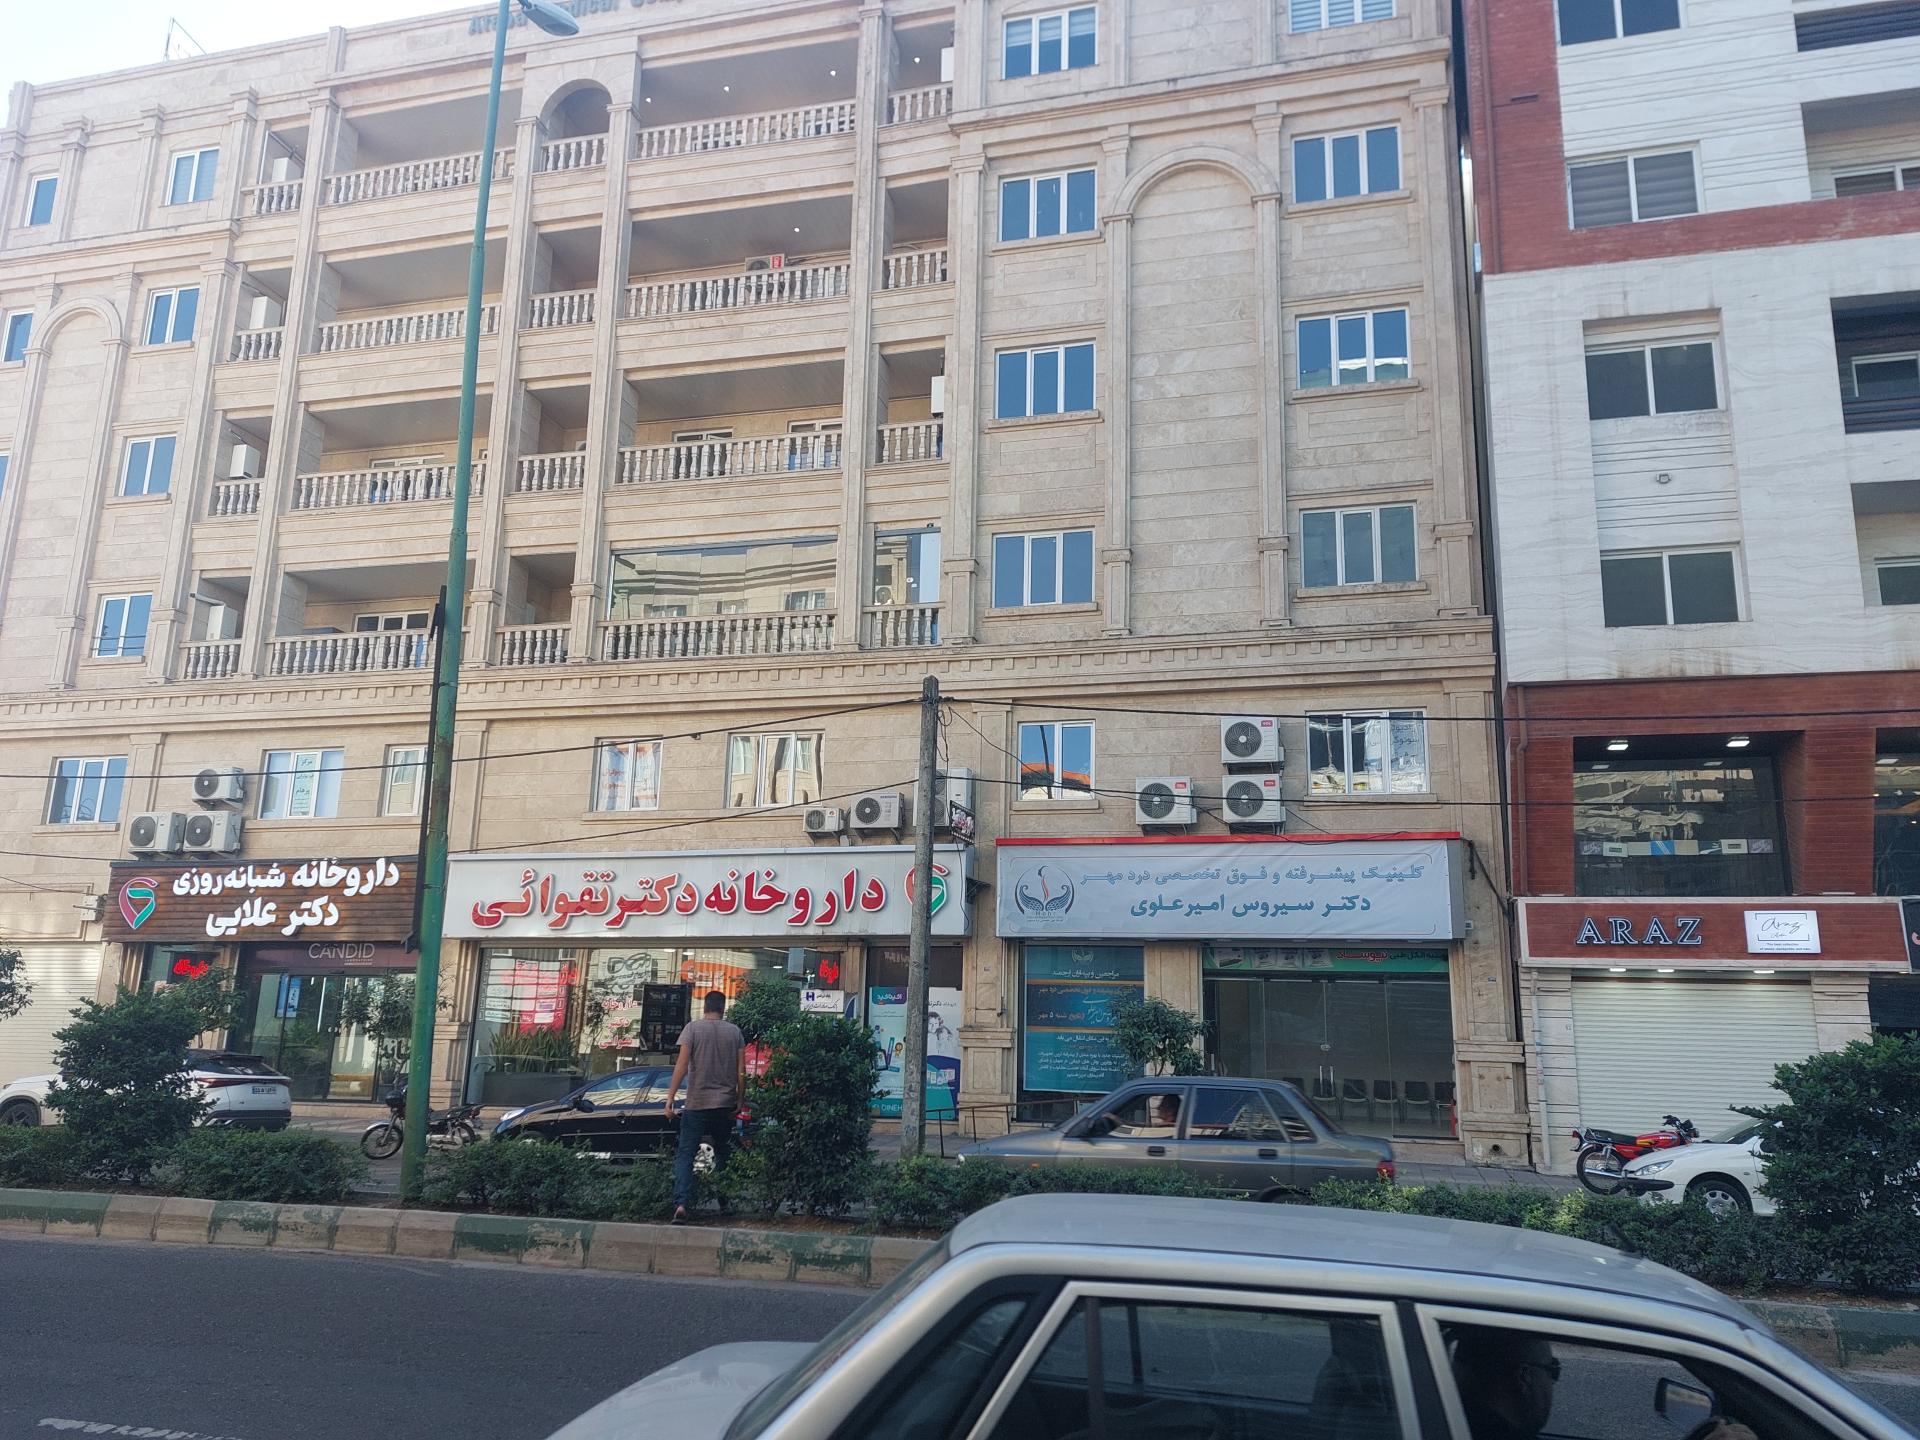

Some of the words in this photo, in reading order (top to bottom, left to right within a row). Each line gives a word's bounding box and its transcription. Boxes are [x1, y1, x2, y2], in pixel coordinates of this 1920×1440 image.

[292, 857, 400, 897] داروخانه
[1080, 870, 1124, 886] مهر
[1127, 869, 1151, 886] درد
[1154, 867, 1222, 886] تخصصی
[1226, 865, 1268, 885] فوق
[1271, 870, 1281, 885] و
[1284, 864, 1356, 885] پیشرفته
[1361, 864, 1425, 883] کلینیک
[470, 867, 613, 929] تقوائی
[603, 872, 700, 929] دکتر
[703, 867, 887, 927] داروخانه
[1321, 894, 1371, 918] دکتر
[205, 896, 278, 938] علایی
[281, 895, 340, 937] دکتر
[1231, 899, 1315, 918] سیروس
[1576, 917, 1703, 945] ARAZ
[308, 942, 376, 959] CANDID
